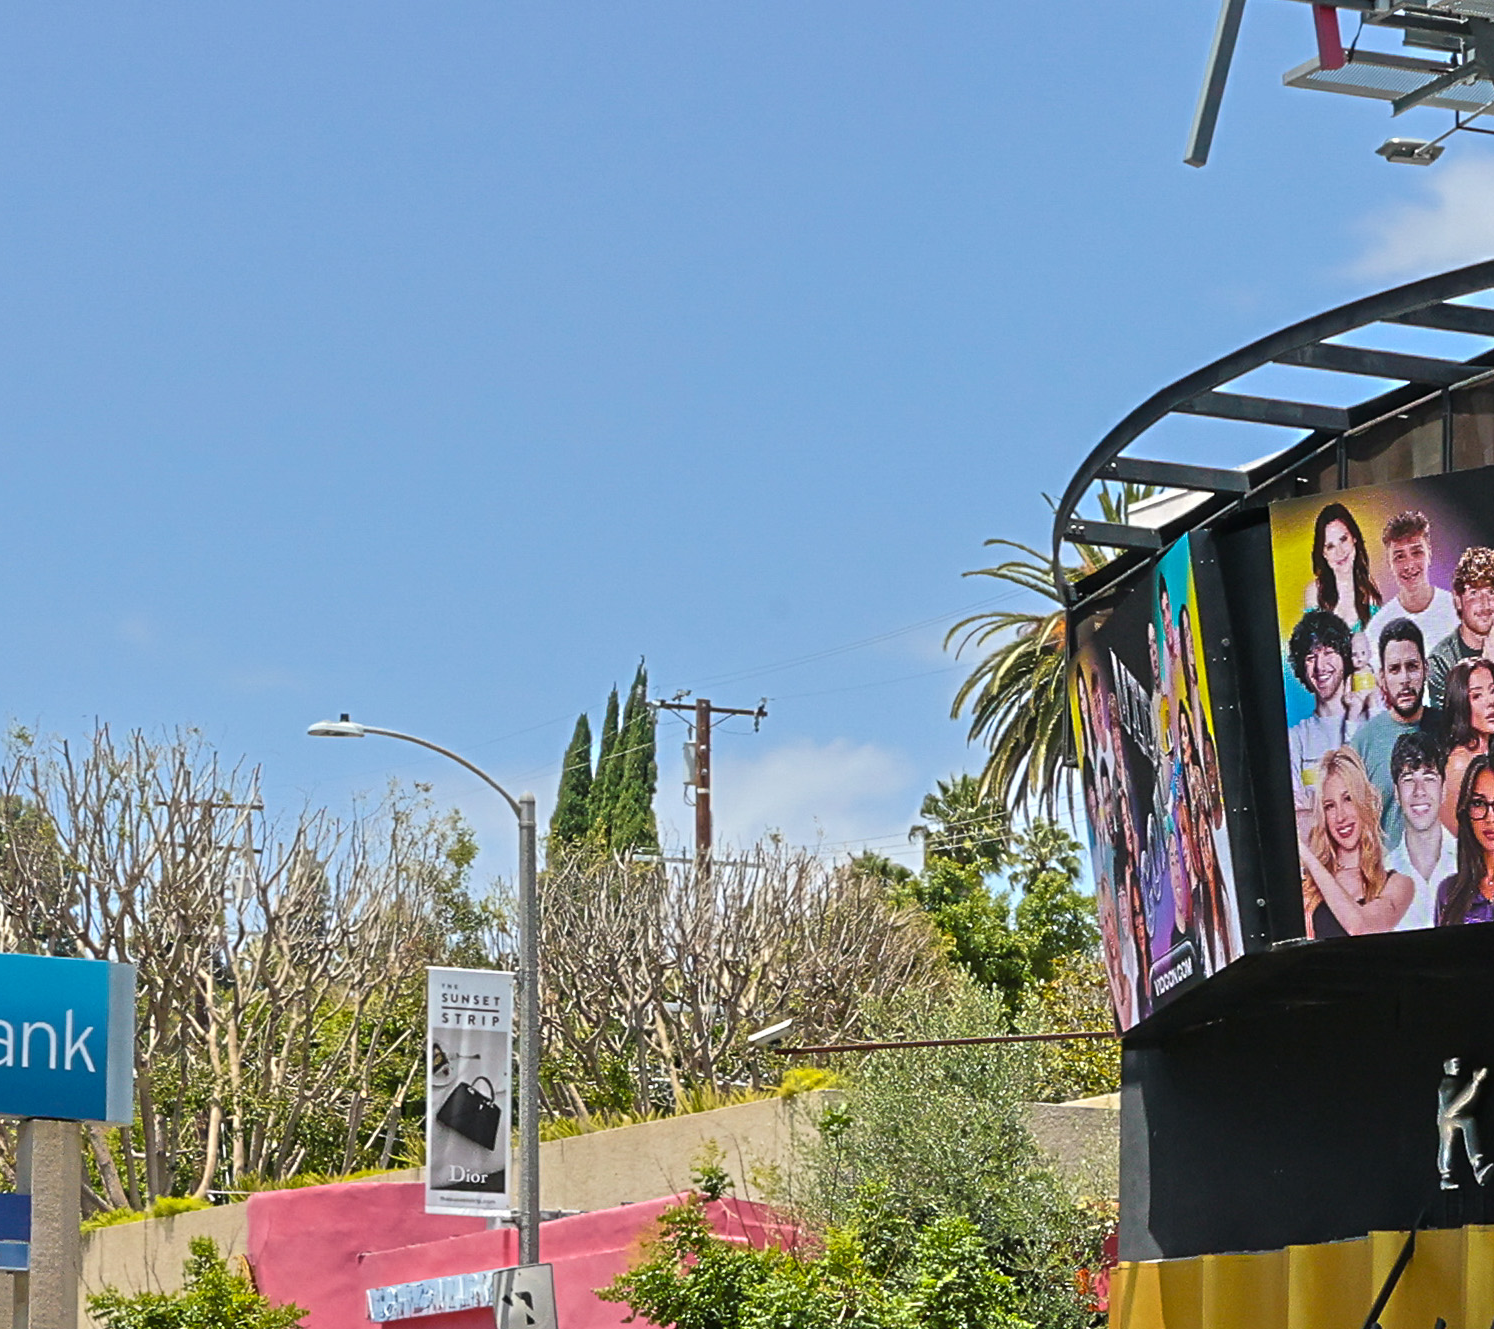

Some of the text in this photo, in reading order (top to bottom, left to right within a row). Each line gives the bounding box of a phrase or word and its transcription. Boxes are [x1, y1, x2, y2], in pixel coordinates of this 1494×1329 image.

[442, 993, 500, 1007] SUNSET
[442, 1012, 500, 1027] STRIP
[448, 1165, 489, 1183] Dior
